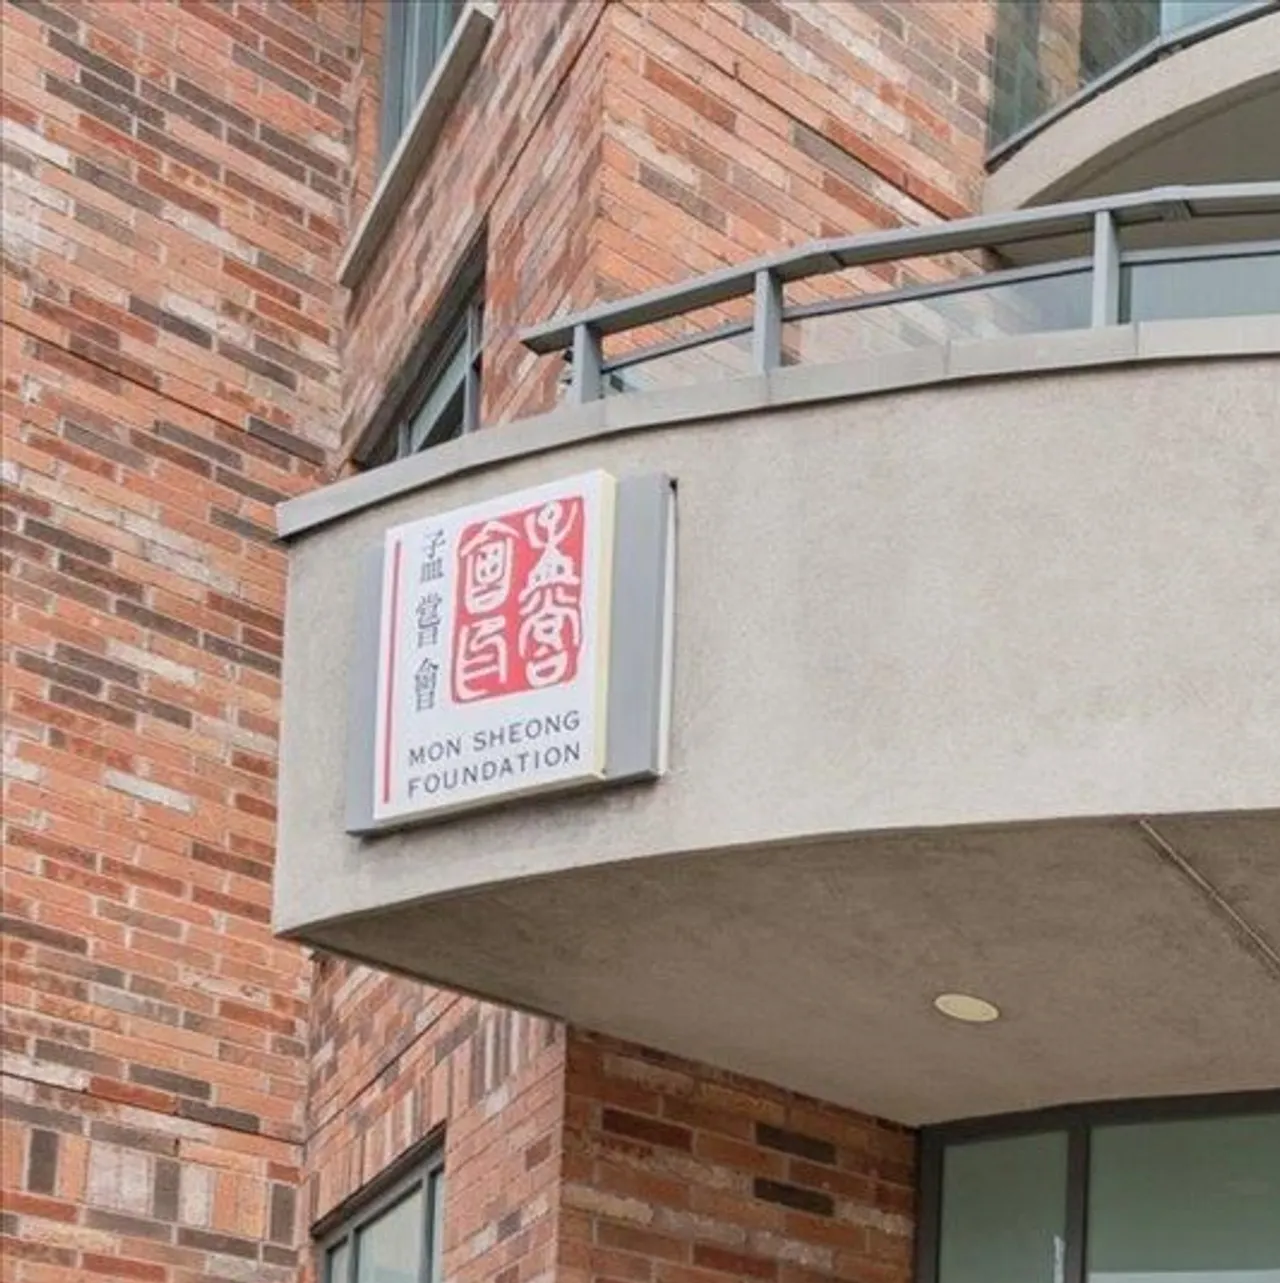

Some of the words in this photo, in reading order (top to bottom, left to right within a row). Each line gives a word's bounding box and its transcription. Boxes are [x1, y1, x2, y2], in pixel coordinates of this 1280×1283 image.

[408, 737, 462, 766] MON
[473, 709, 581, 752] SHEONG
[408, 741, 581, 799] FOUNDATION
